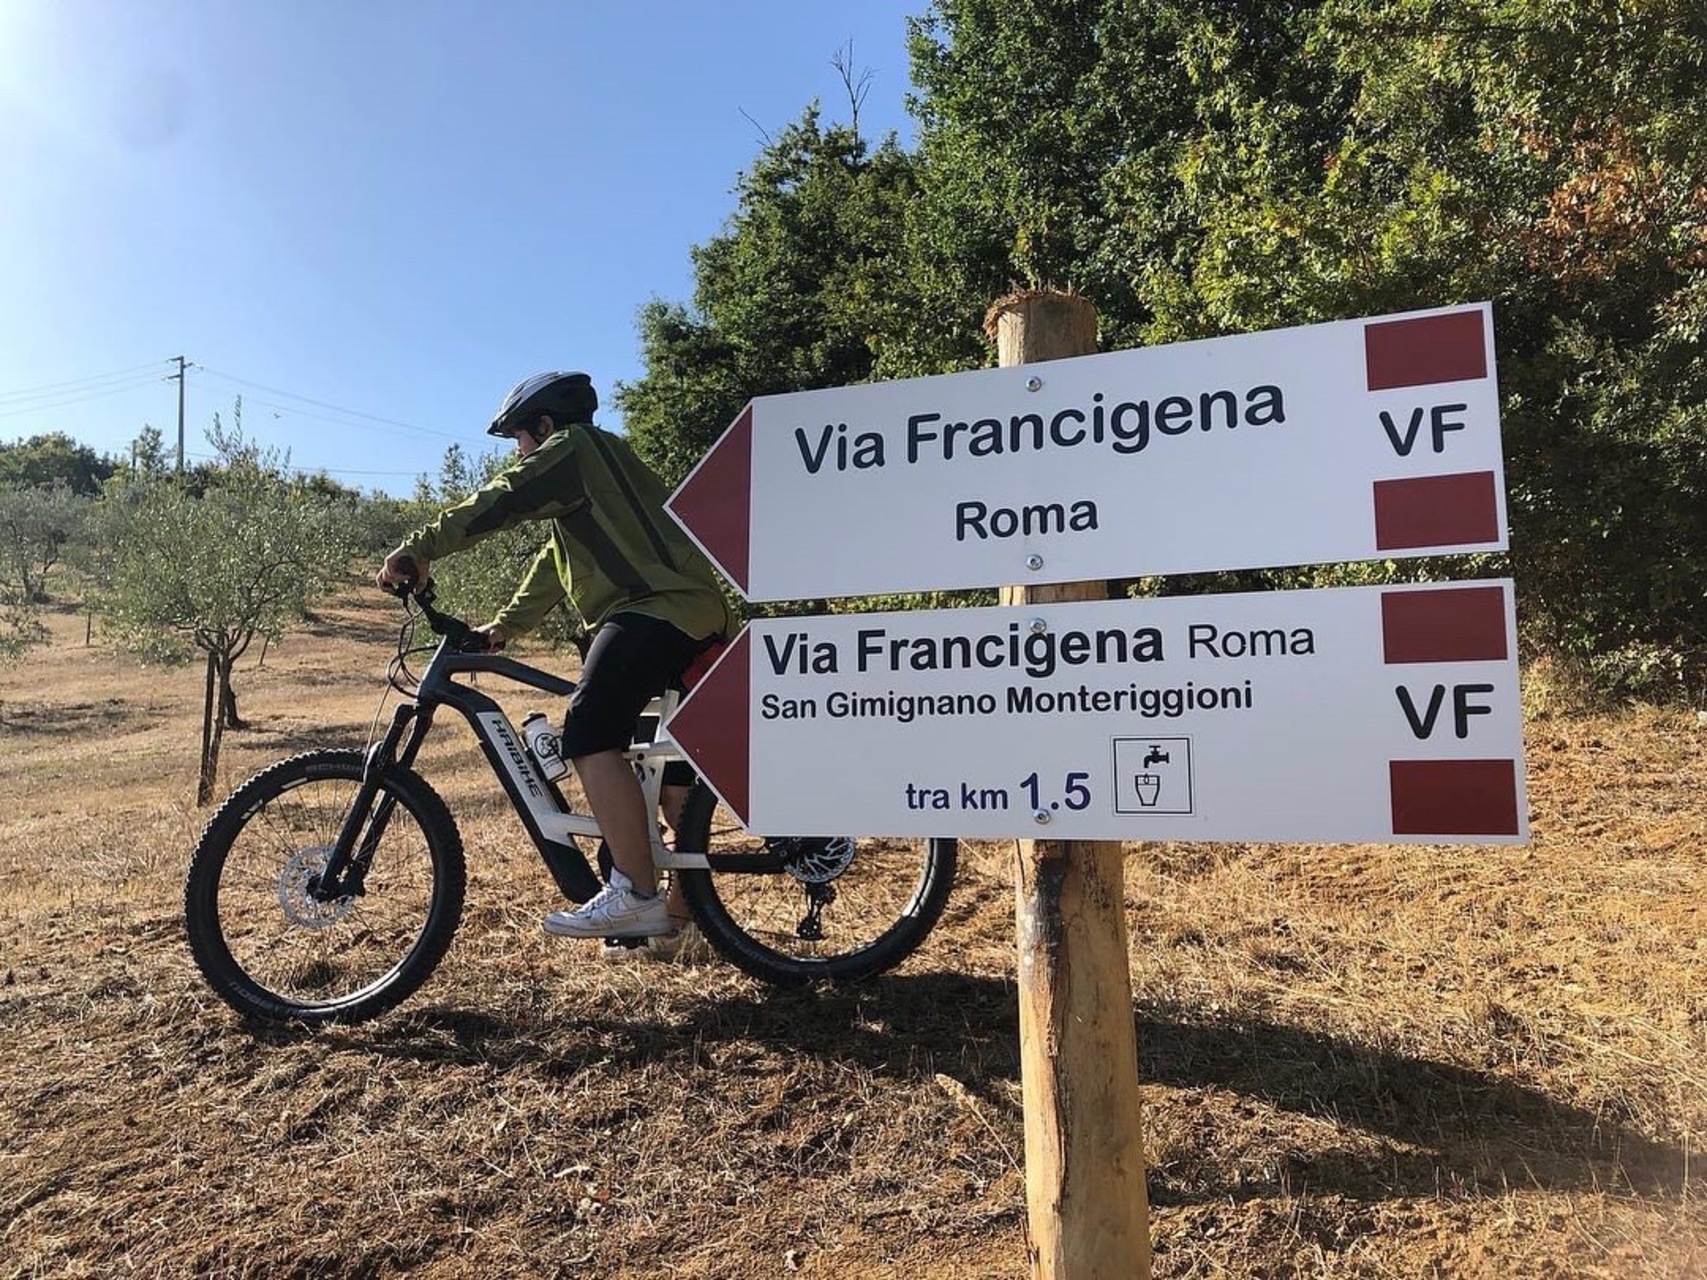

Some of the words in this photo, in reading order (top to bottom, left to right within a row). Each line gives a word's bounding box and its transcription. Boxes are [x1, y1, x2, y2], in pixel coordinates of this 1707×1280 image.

[795, 423, 886, 475] Via
[906, 383, 1286, 463] Francigena
[1378, 402, 1469, 457] VF
[955, 499, 1099, 542] Roma
[762, 631, 839, 677] Via
[856, 625, 1165, 678] Francigena
[1188, 622, 1315, 660] Roma
[761, 691, 817, 720] San
[826, 690, 997, 724] Gimignano
[1005, 681, 1253, 720] Monteriggioni
[1395, 682, 1495, 740] VF
[905, 782, 951, 811] tra
[960, 780, 1009, 812] km
[1019, 771, 1093, 812] 1.5
